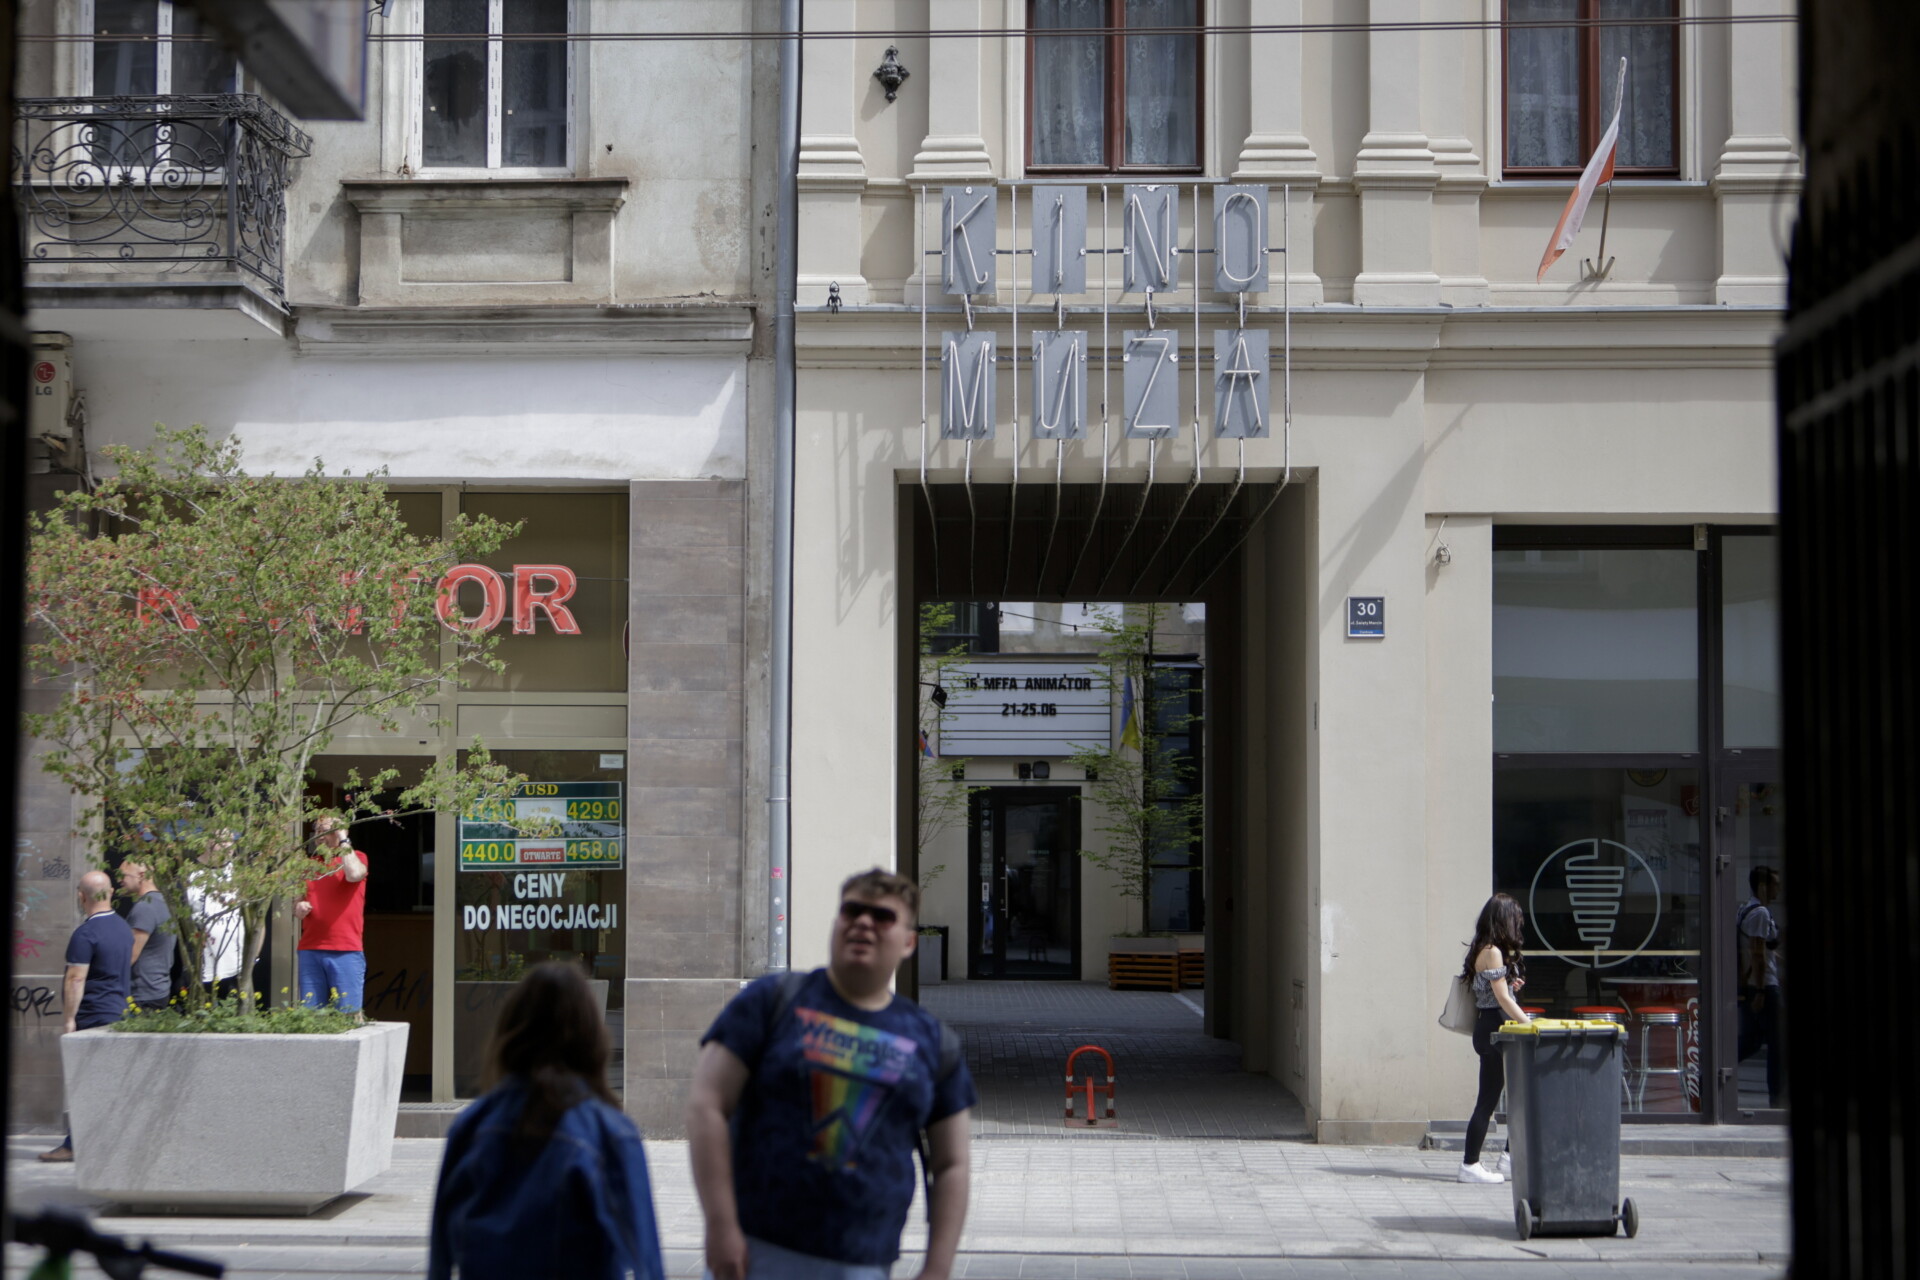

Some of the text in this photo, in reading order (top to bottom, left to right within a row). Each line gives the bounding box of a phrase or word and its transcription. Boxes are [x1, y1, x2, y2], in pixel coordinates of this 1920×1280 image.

[948, 191, 1262, 287] KINO
[35, 385, 53, 396] LG
[948, 336, 1262, 432] MUZA
[137, 563, 582, 636] KTOR
[1357, 602, 1376, 615] 30
[984, 677, 1018, 690] MFFA
[1024, 677, 1091, 690] ANIMATOR
[1002, 703, 1057, 716] 21-25.06
[524, 783, 559, 796] USD
[566, 800, 620, 820] 429.0
[462, 842, 516, 863] 440.0
[523, 851, 562, 861] OTWARTE
[566, 840, 620, 861] 458.0
[514, 873, 566, 898] CENY
[463, 903, 618, 930] DO NEGOCJACJI
